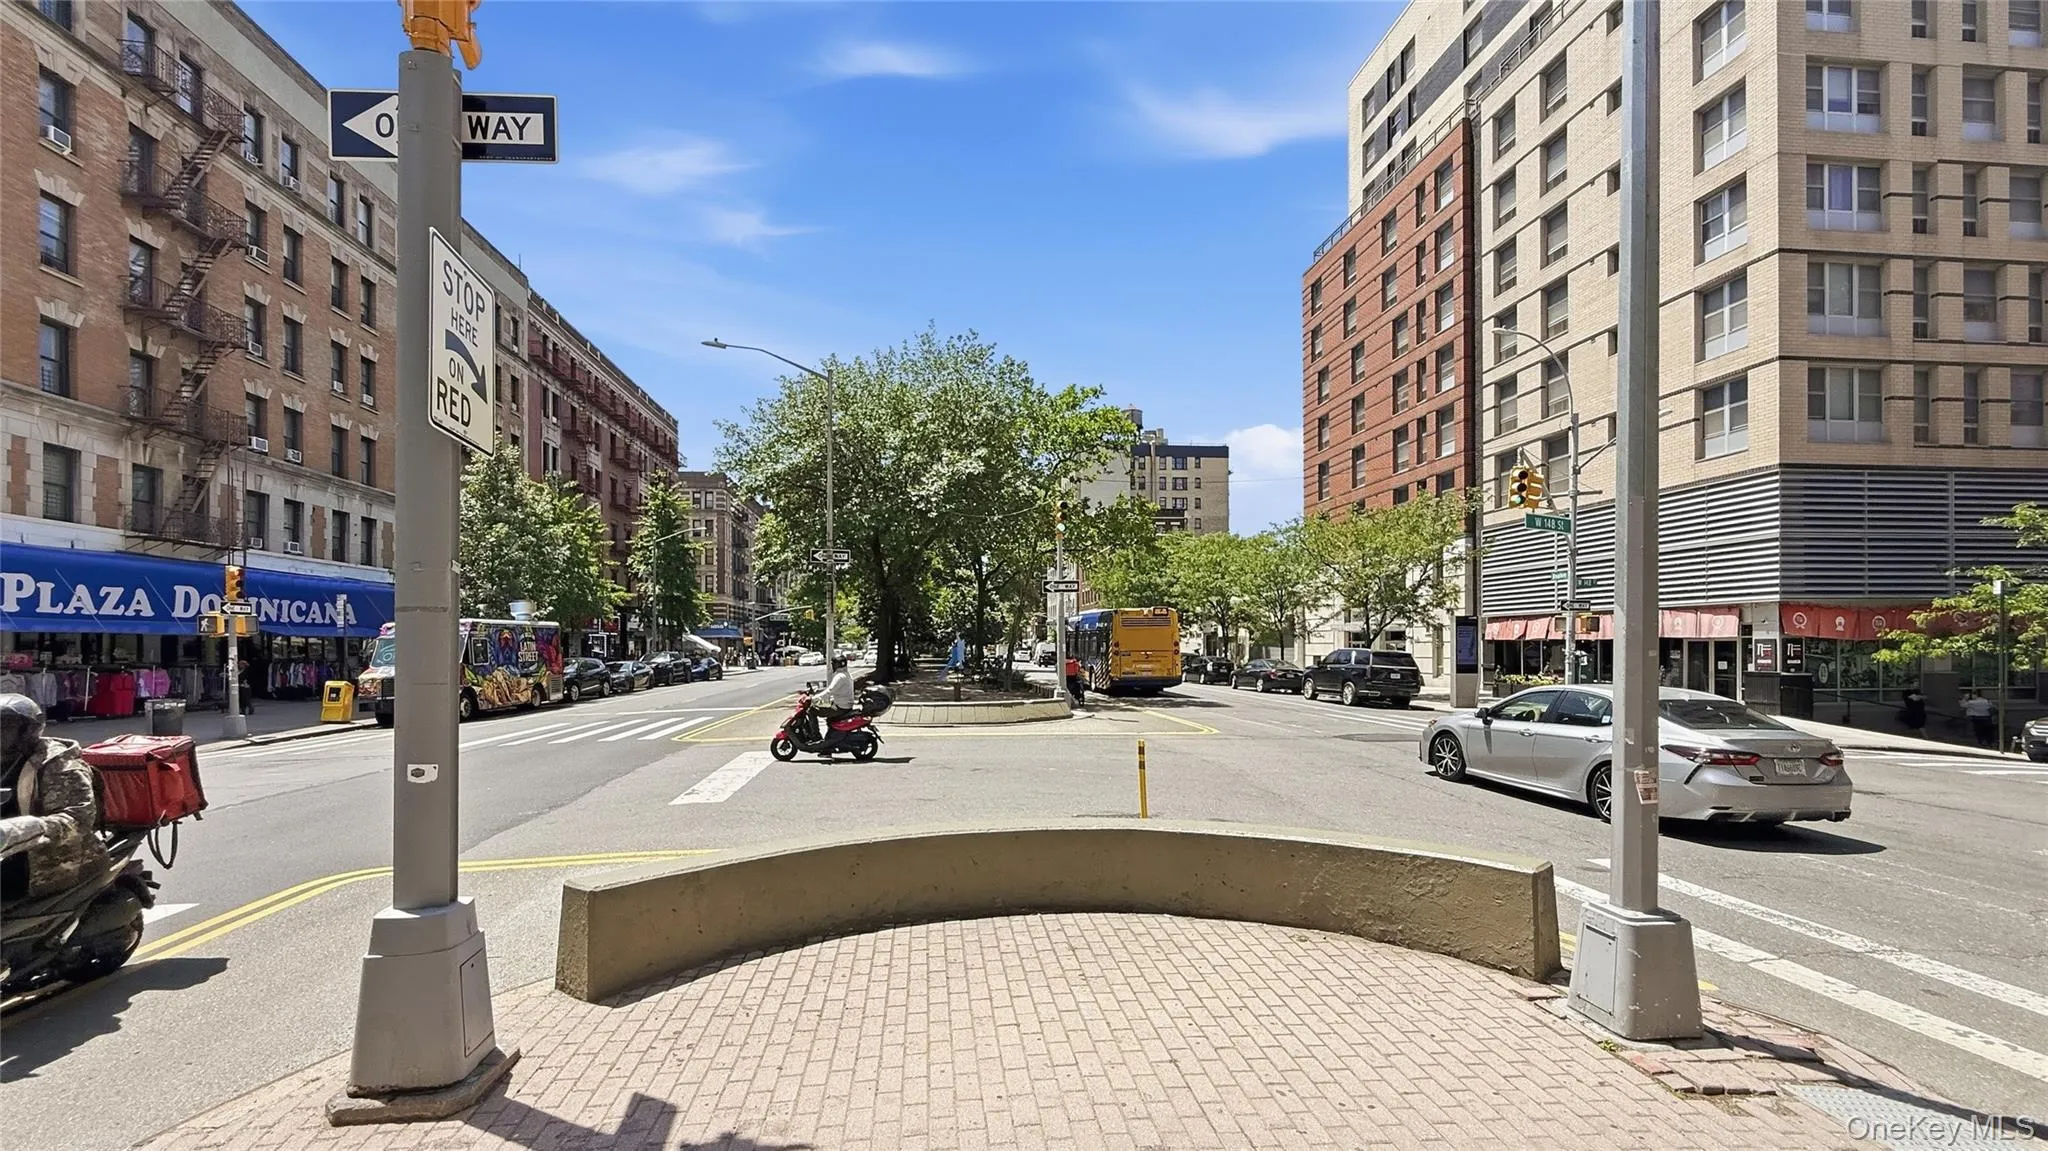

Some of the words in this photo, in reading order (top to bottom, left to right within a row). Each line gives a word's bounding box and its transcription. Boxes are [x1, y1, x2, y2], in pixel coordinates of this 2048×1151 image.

[467, 115, 532, 141] WAY
[443, 259, 486, 322] STOP
[450, 307, 478, 348] HERE
[449, 357, 464, 385] ON
[436, 376, 472, 428] RED
[1535, 517, 1541, 527] W
[1544, 519, 1556, 529] 148
[0, 572, 155, 617] PLAZA
[171, 584, 357, 624] DOINICANA
